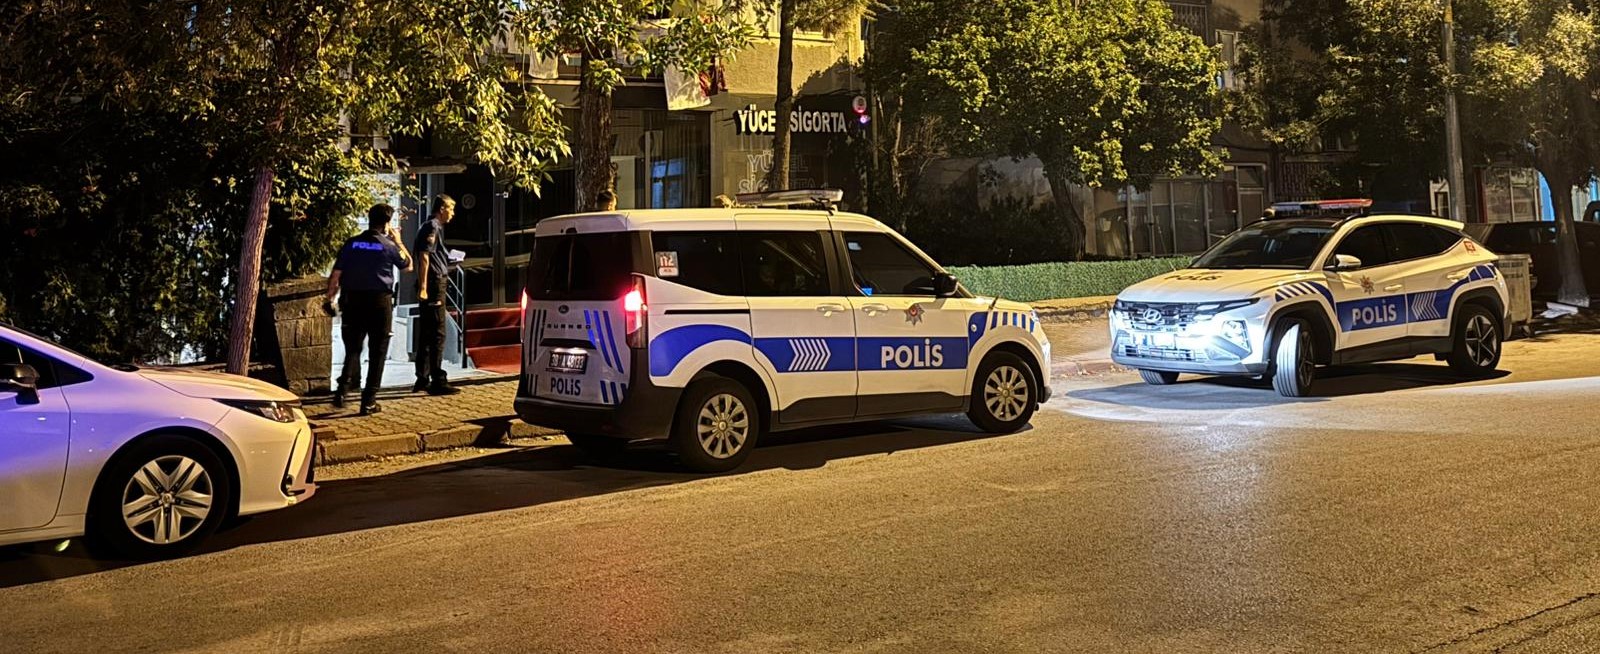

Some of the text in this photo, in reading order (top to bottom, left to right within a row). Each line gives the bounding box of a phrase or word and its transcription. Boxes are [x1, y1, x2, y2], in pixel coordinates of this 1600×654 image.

[738, 104, 847, 133] YÜCE SİGORTA
[747, 149, 809, 173] YÜEL
[1352, 298, 1397, 326] POLİS
[881, 338, 944, 369] POLİS
[550, 377, 581, 396] POLİS
